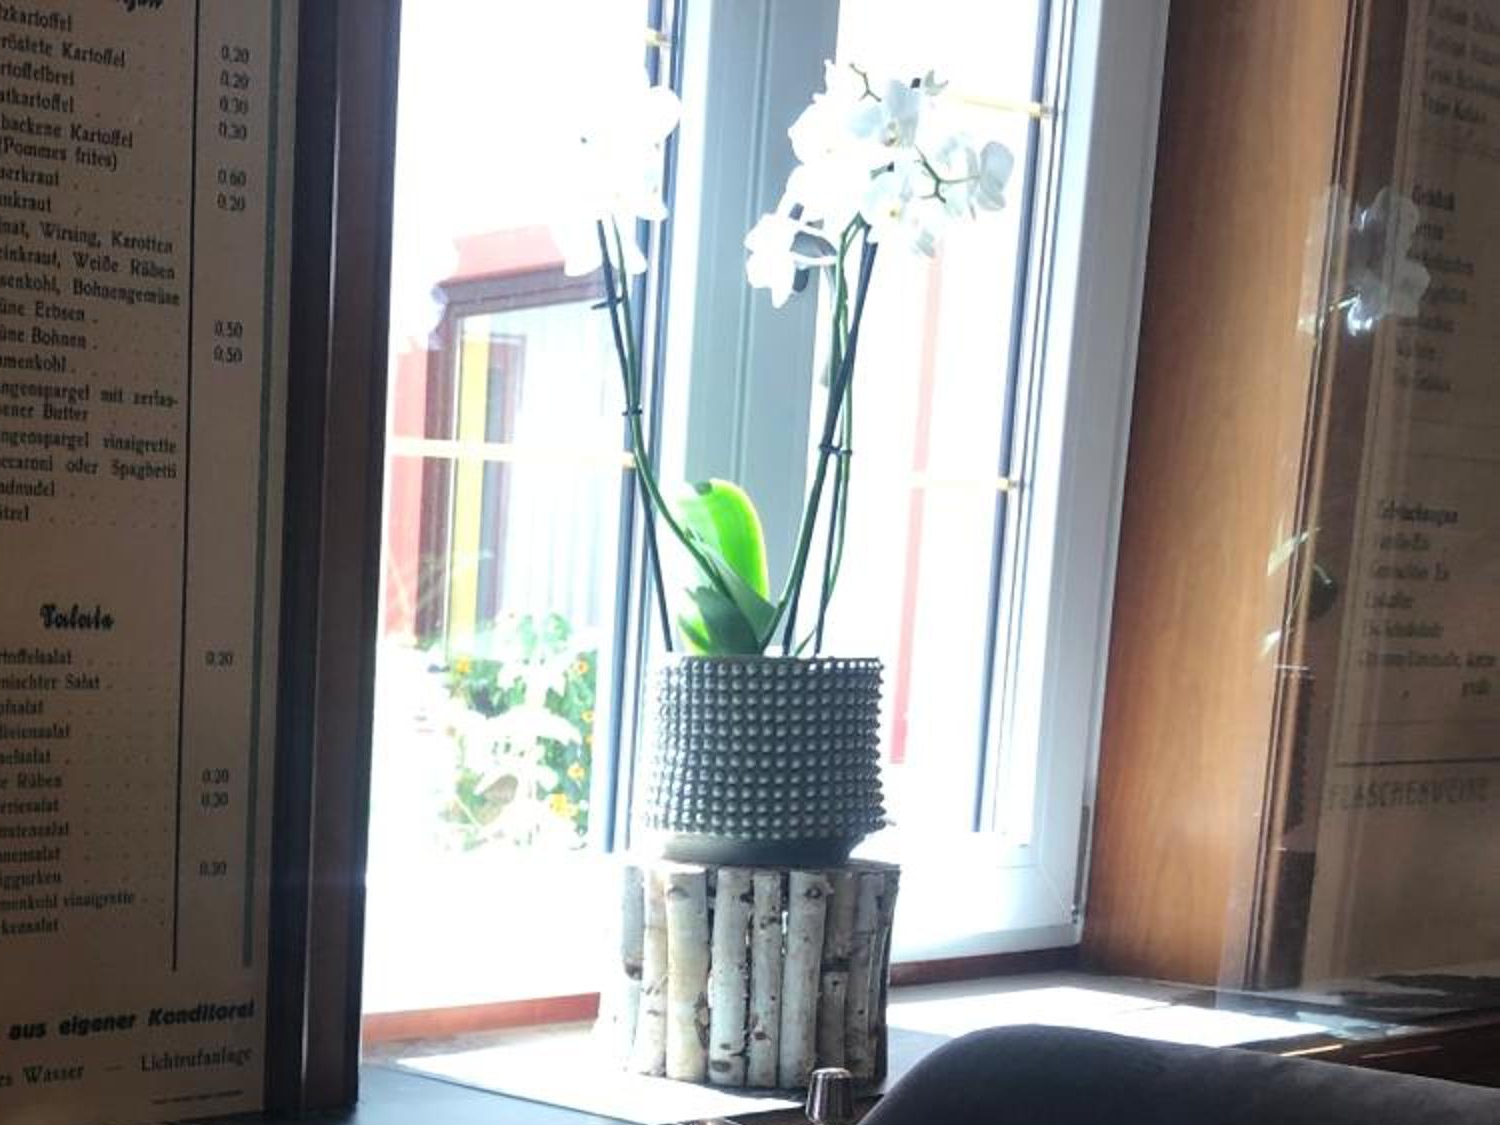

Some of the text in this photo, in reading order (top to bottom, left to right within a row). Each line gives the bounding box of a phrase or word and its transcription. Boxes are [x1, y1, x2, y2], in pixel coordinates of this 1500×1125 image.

[62, 42, 125, 67] Kartoffel
[71, 124, 133, 149] Kartoffel
[8, 1022, 47, 1041] aus
[59, 1010, 137, 1037] eigener
[147, 1001, 255, 1027] Konditorei
[22, 1063, 85, 1088] Wasser
